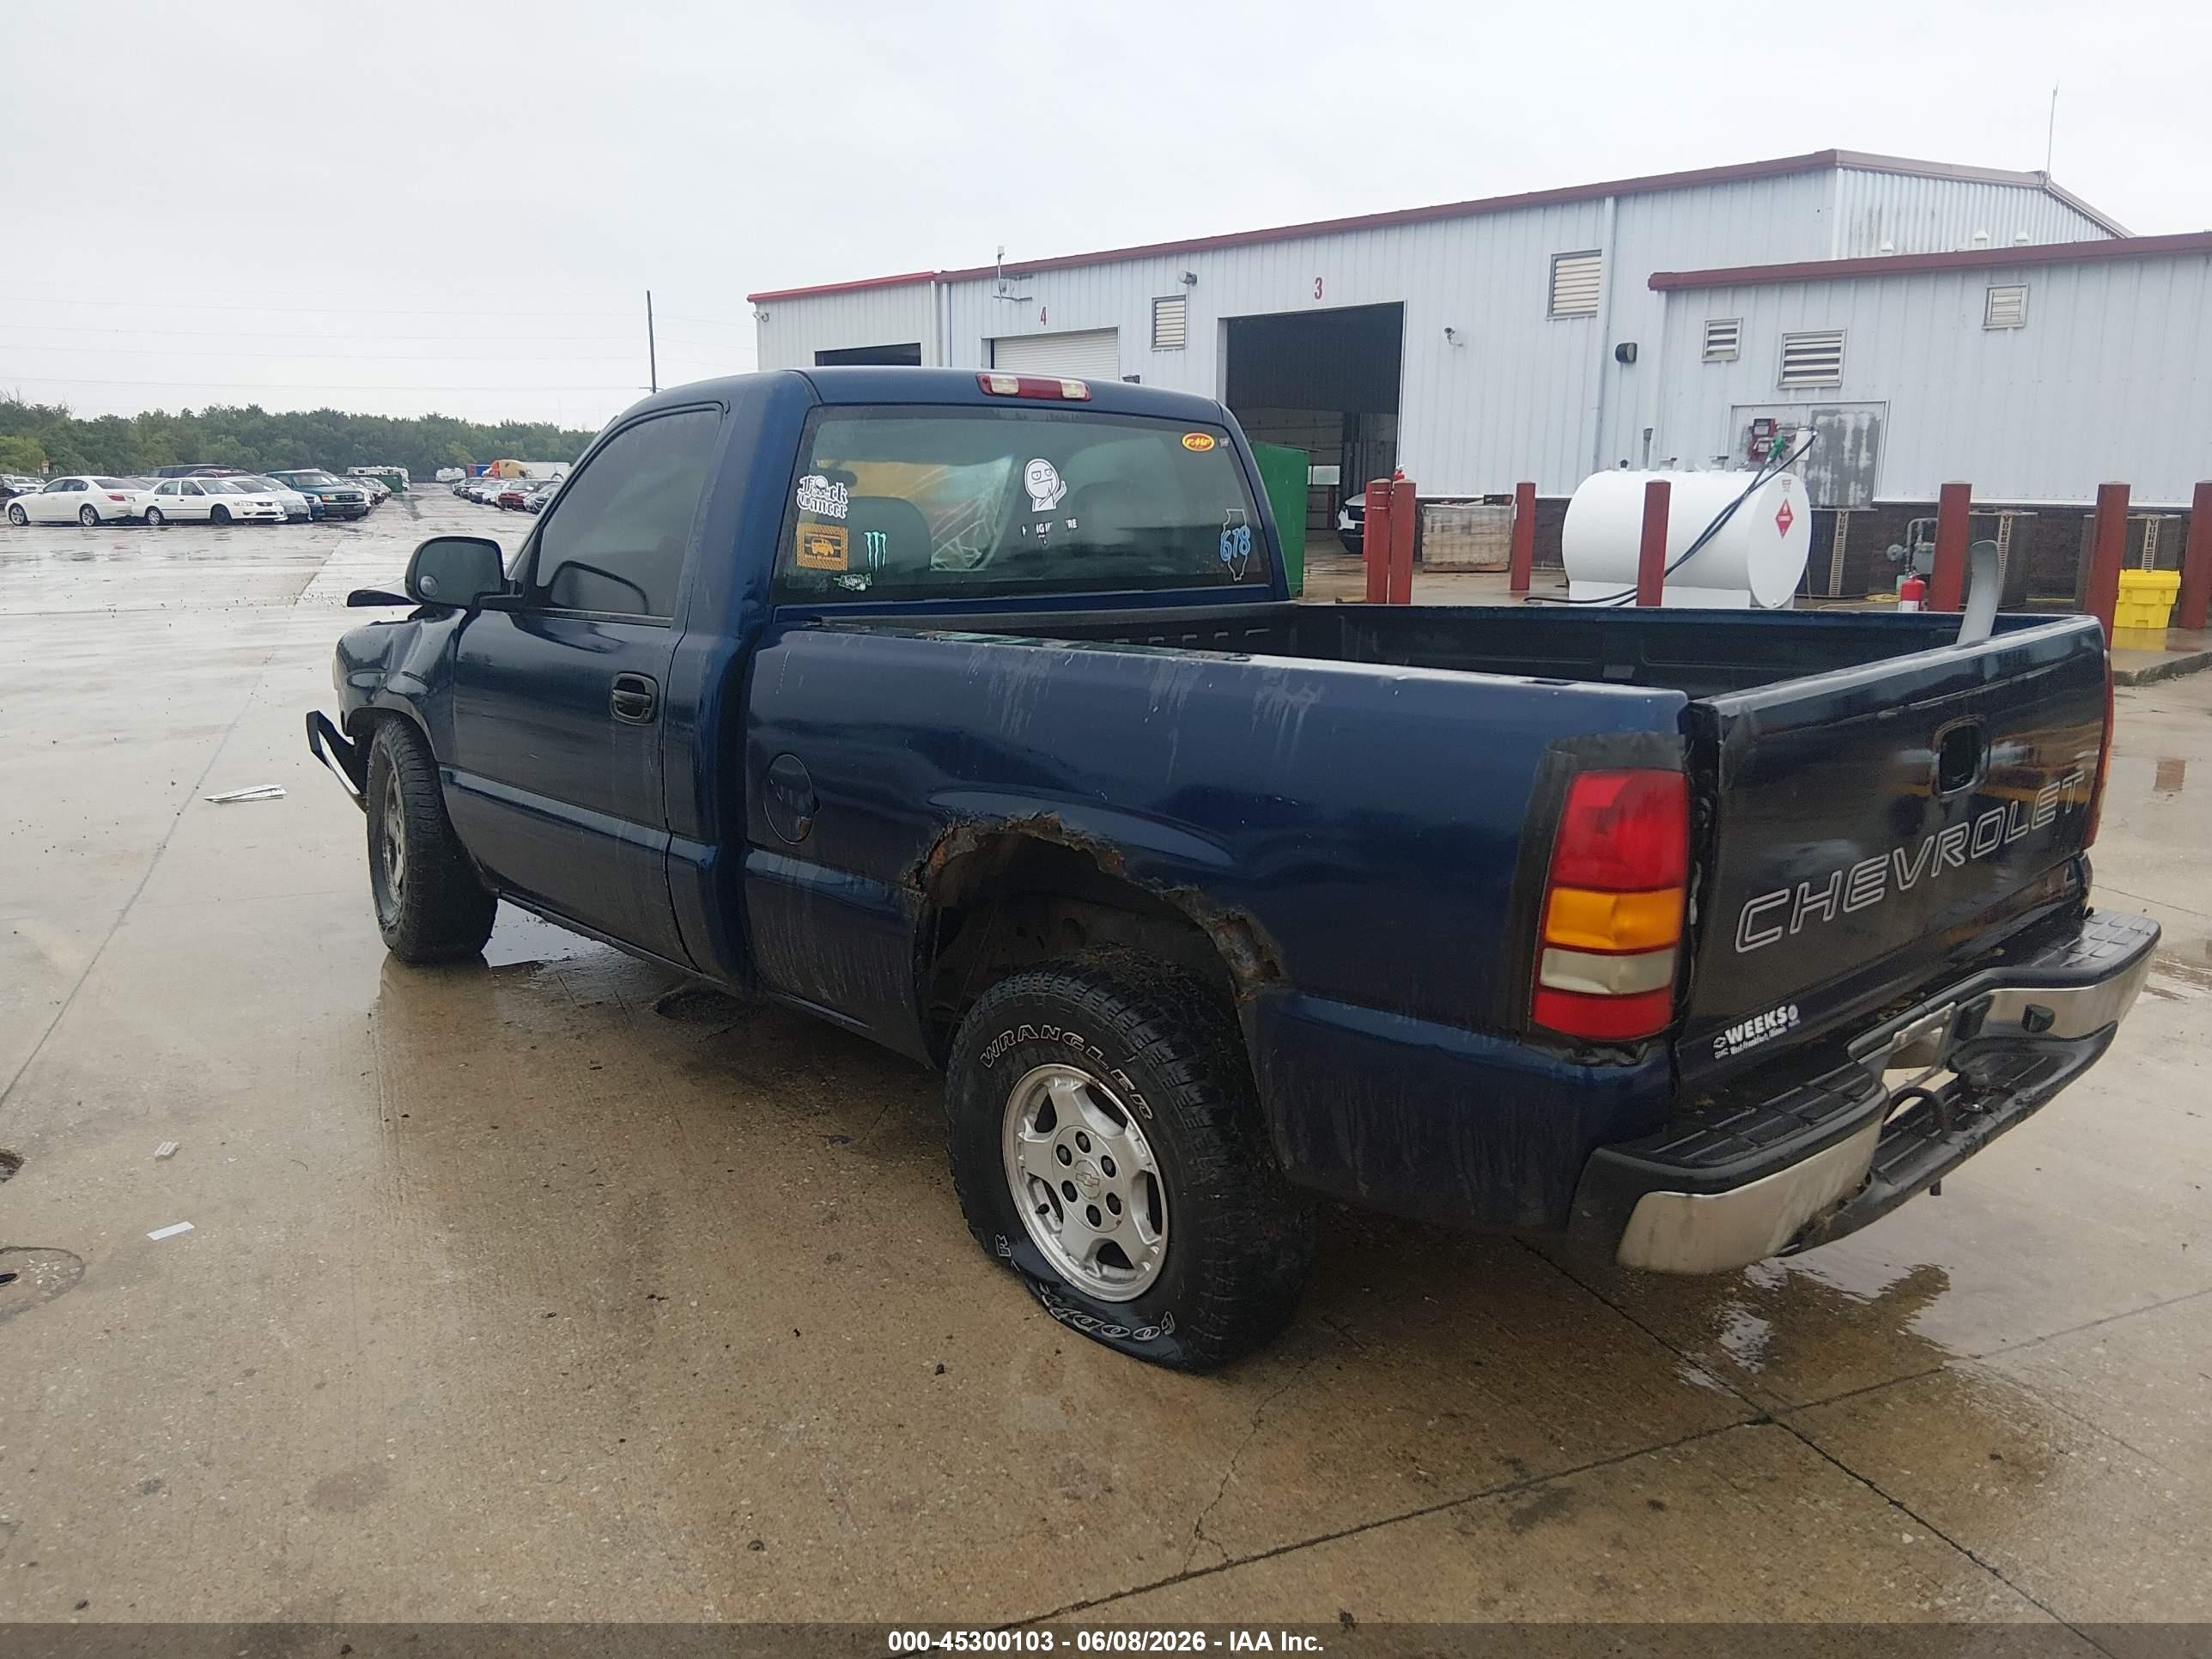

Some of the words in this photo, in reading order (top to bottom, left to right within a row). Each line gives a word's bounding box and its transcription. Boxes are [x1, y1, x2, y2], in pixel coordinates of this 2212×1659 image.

[1314, 276, 1322, 300] 3
[1040, 306, 1047, 325] 4
[797, 493, 848, 519] Cancer
[1219, 525, 1251, 562] 618
[1735, 770, 2085, 953] CHEVROLET
[1724, 1006, 1789, 1045] WEEKS
[979, 1024, 1154, 1121] WRANGLER
[994, 1233, 1176, 1341] GOODYER
